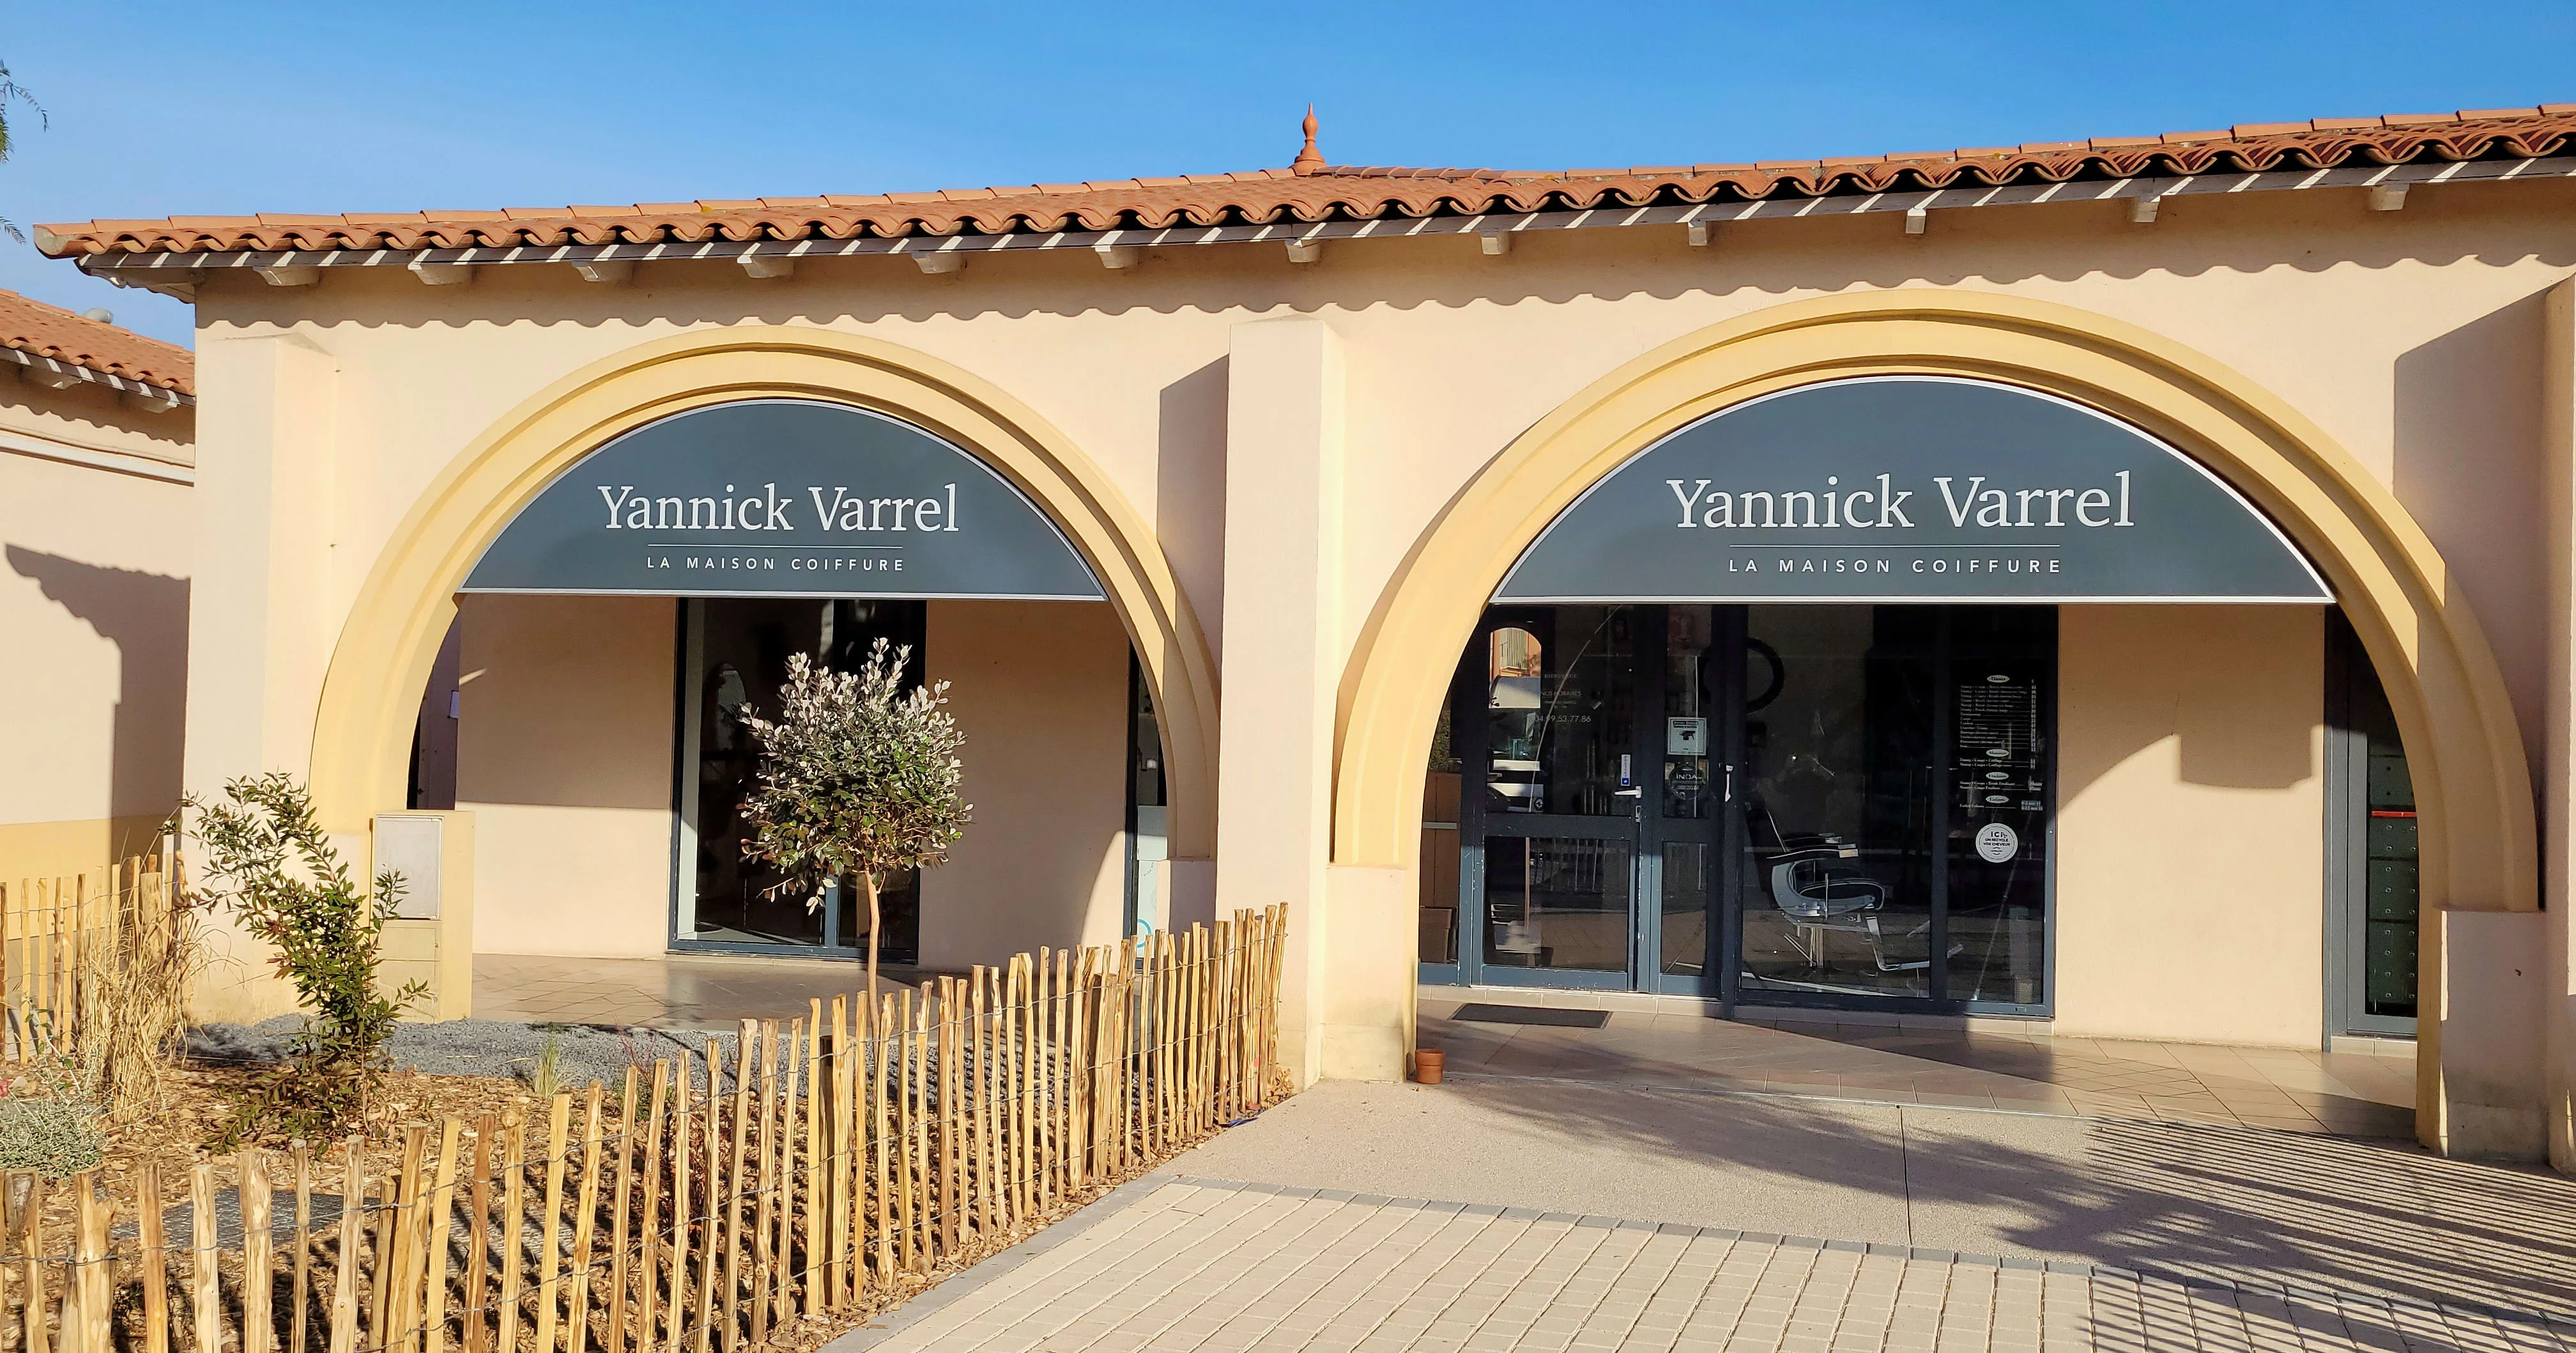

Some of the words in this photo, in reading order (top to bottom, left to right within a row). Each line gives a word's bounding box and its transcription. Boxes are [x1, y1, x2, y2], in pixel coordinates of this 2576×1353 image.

[597, 483, 794, 530] Yannick
[808, 483, 959, 532] Varrel
[1666, 473, 1915, 528] Yannick
[1934, 470, 2135, 527] Varrel
[647, 557, 670, 568] LA
[687, 557, 774, 569] MAISON
[791, 559, 903, 571] COIFFURE
[1729, 559, 1758, 572] LA
[1779, 559, 1889, 573] MAISON
[1912, 559, 2060, 573] COIFFURE
